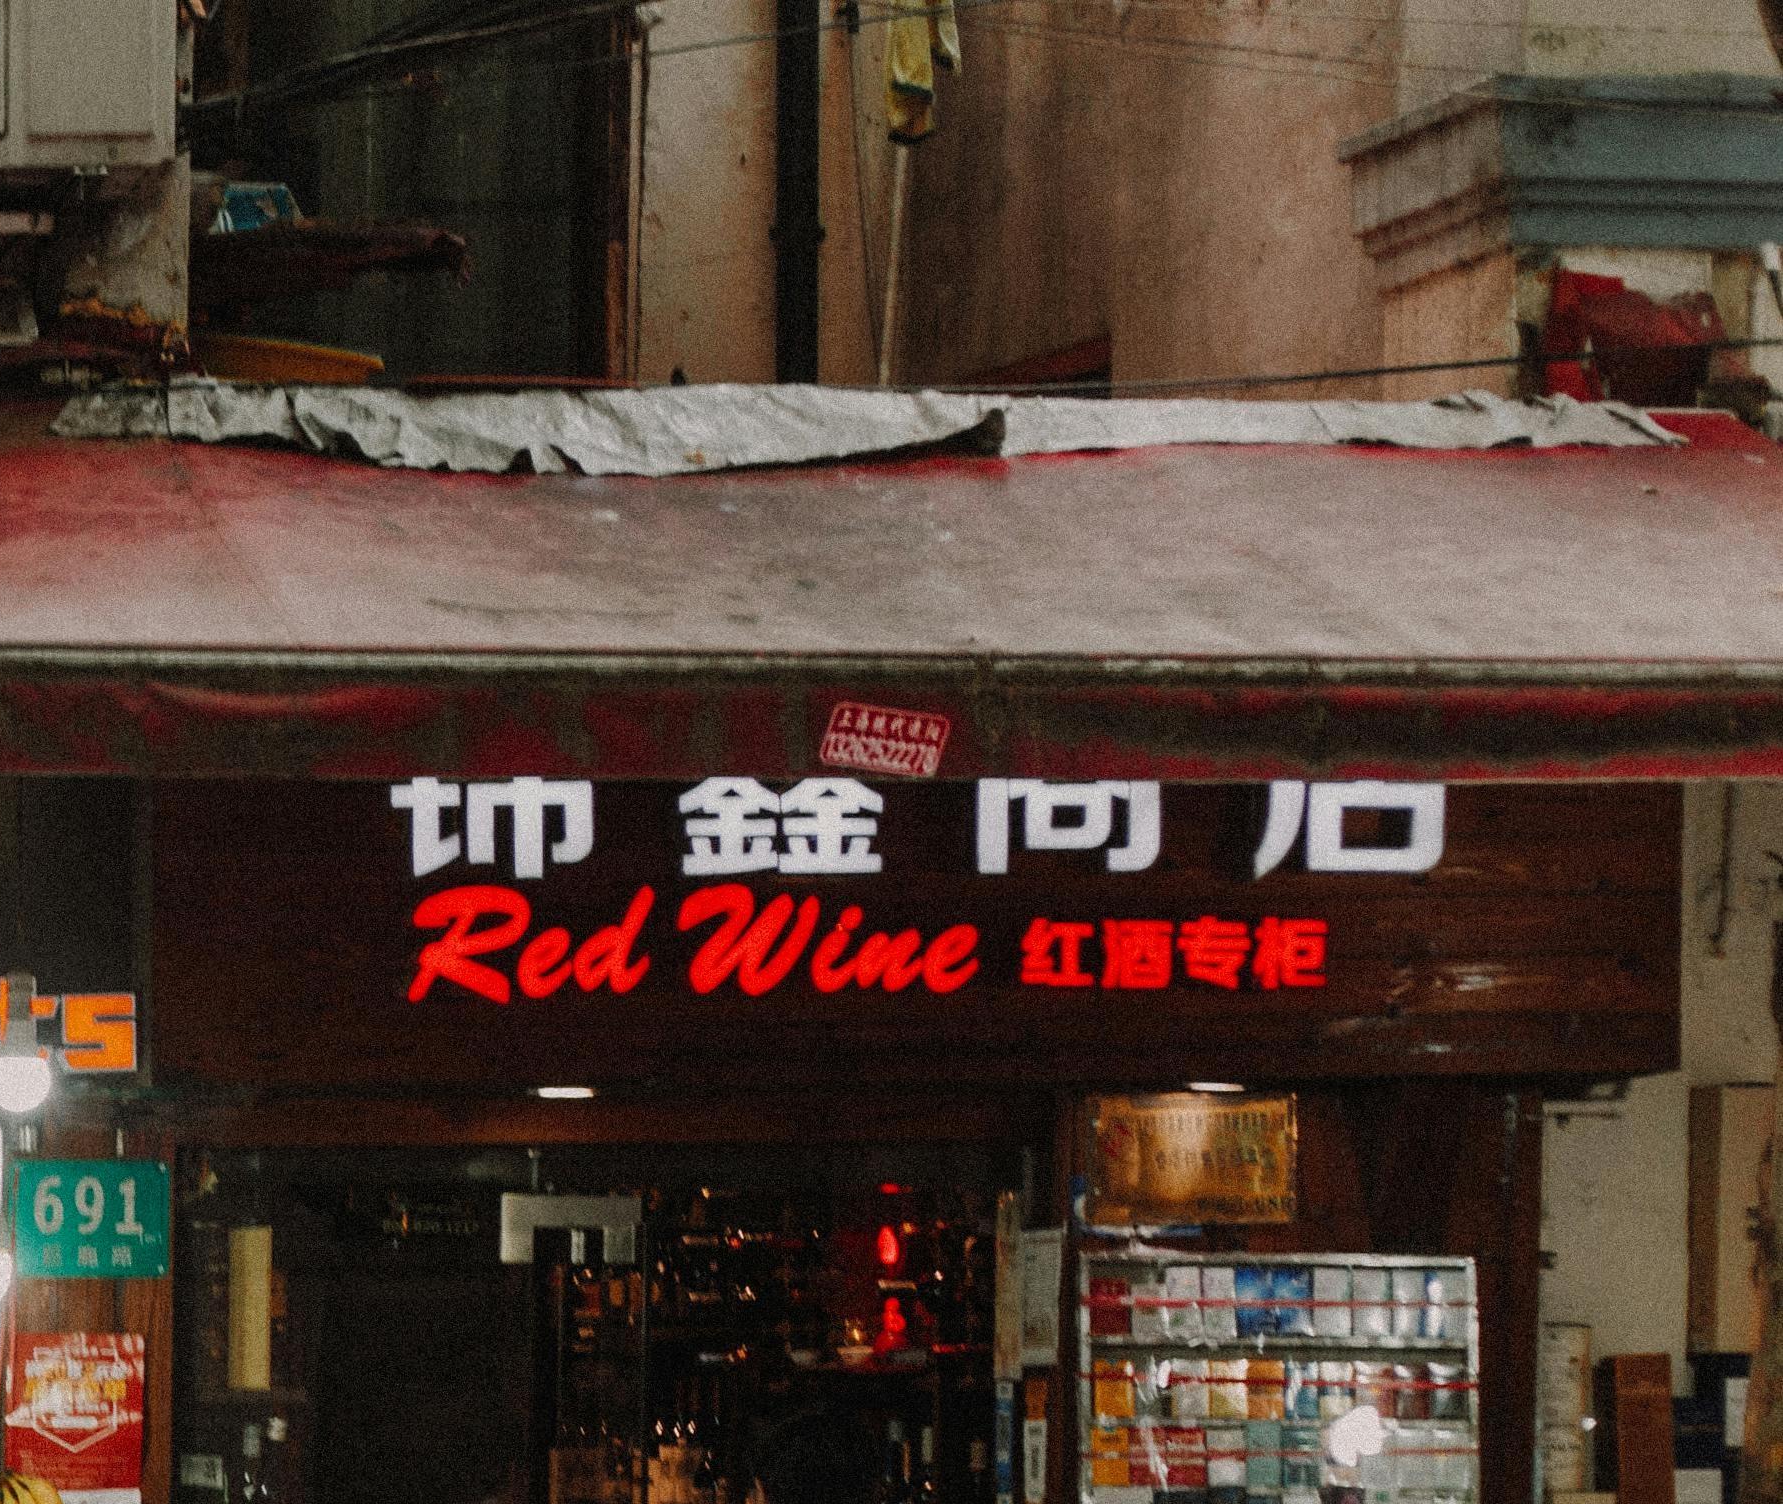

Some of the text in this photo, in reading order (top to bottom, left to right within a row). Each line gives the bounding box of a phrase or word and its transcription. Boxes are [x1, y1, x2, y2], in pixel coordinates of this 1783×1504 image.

[408, 883, 979, 1004] Red Wine
[1020, 916, 1328, 989] 红酒专柜
[32, 1174, 145, 1236] 691
